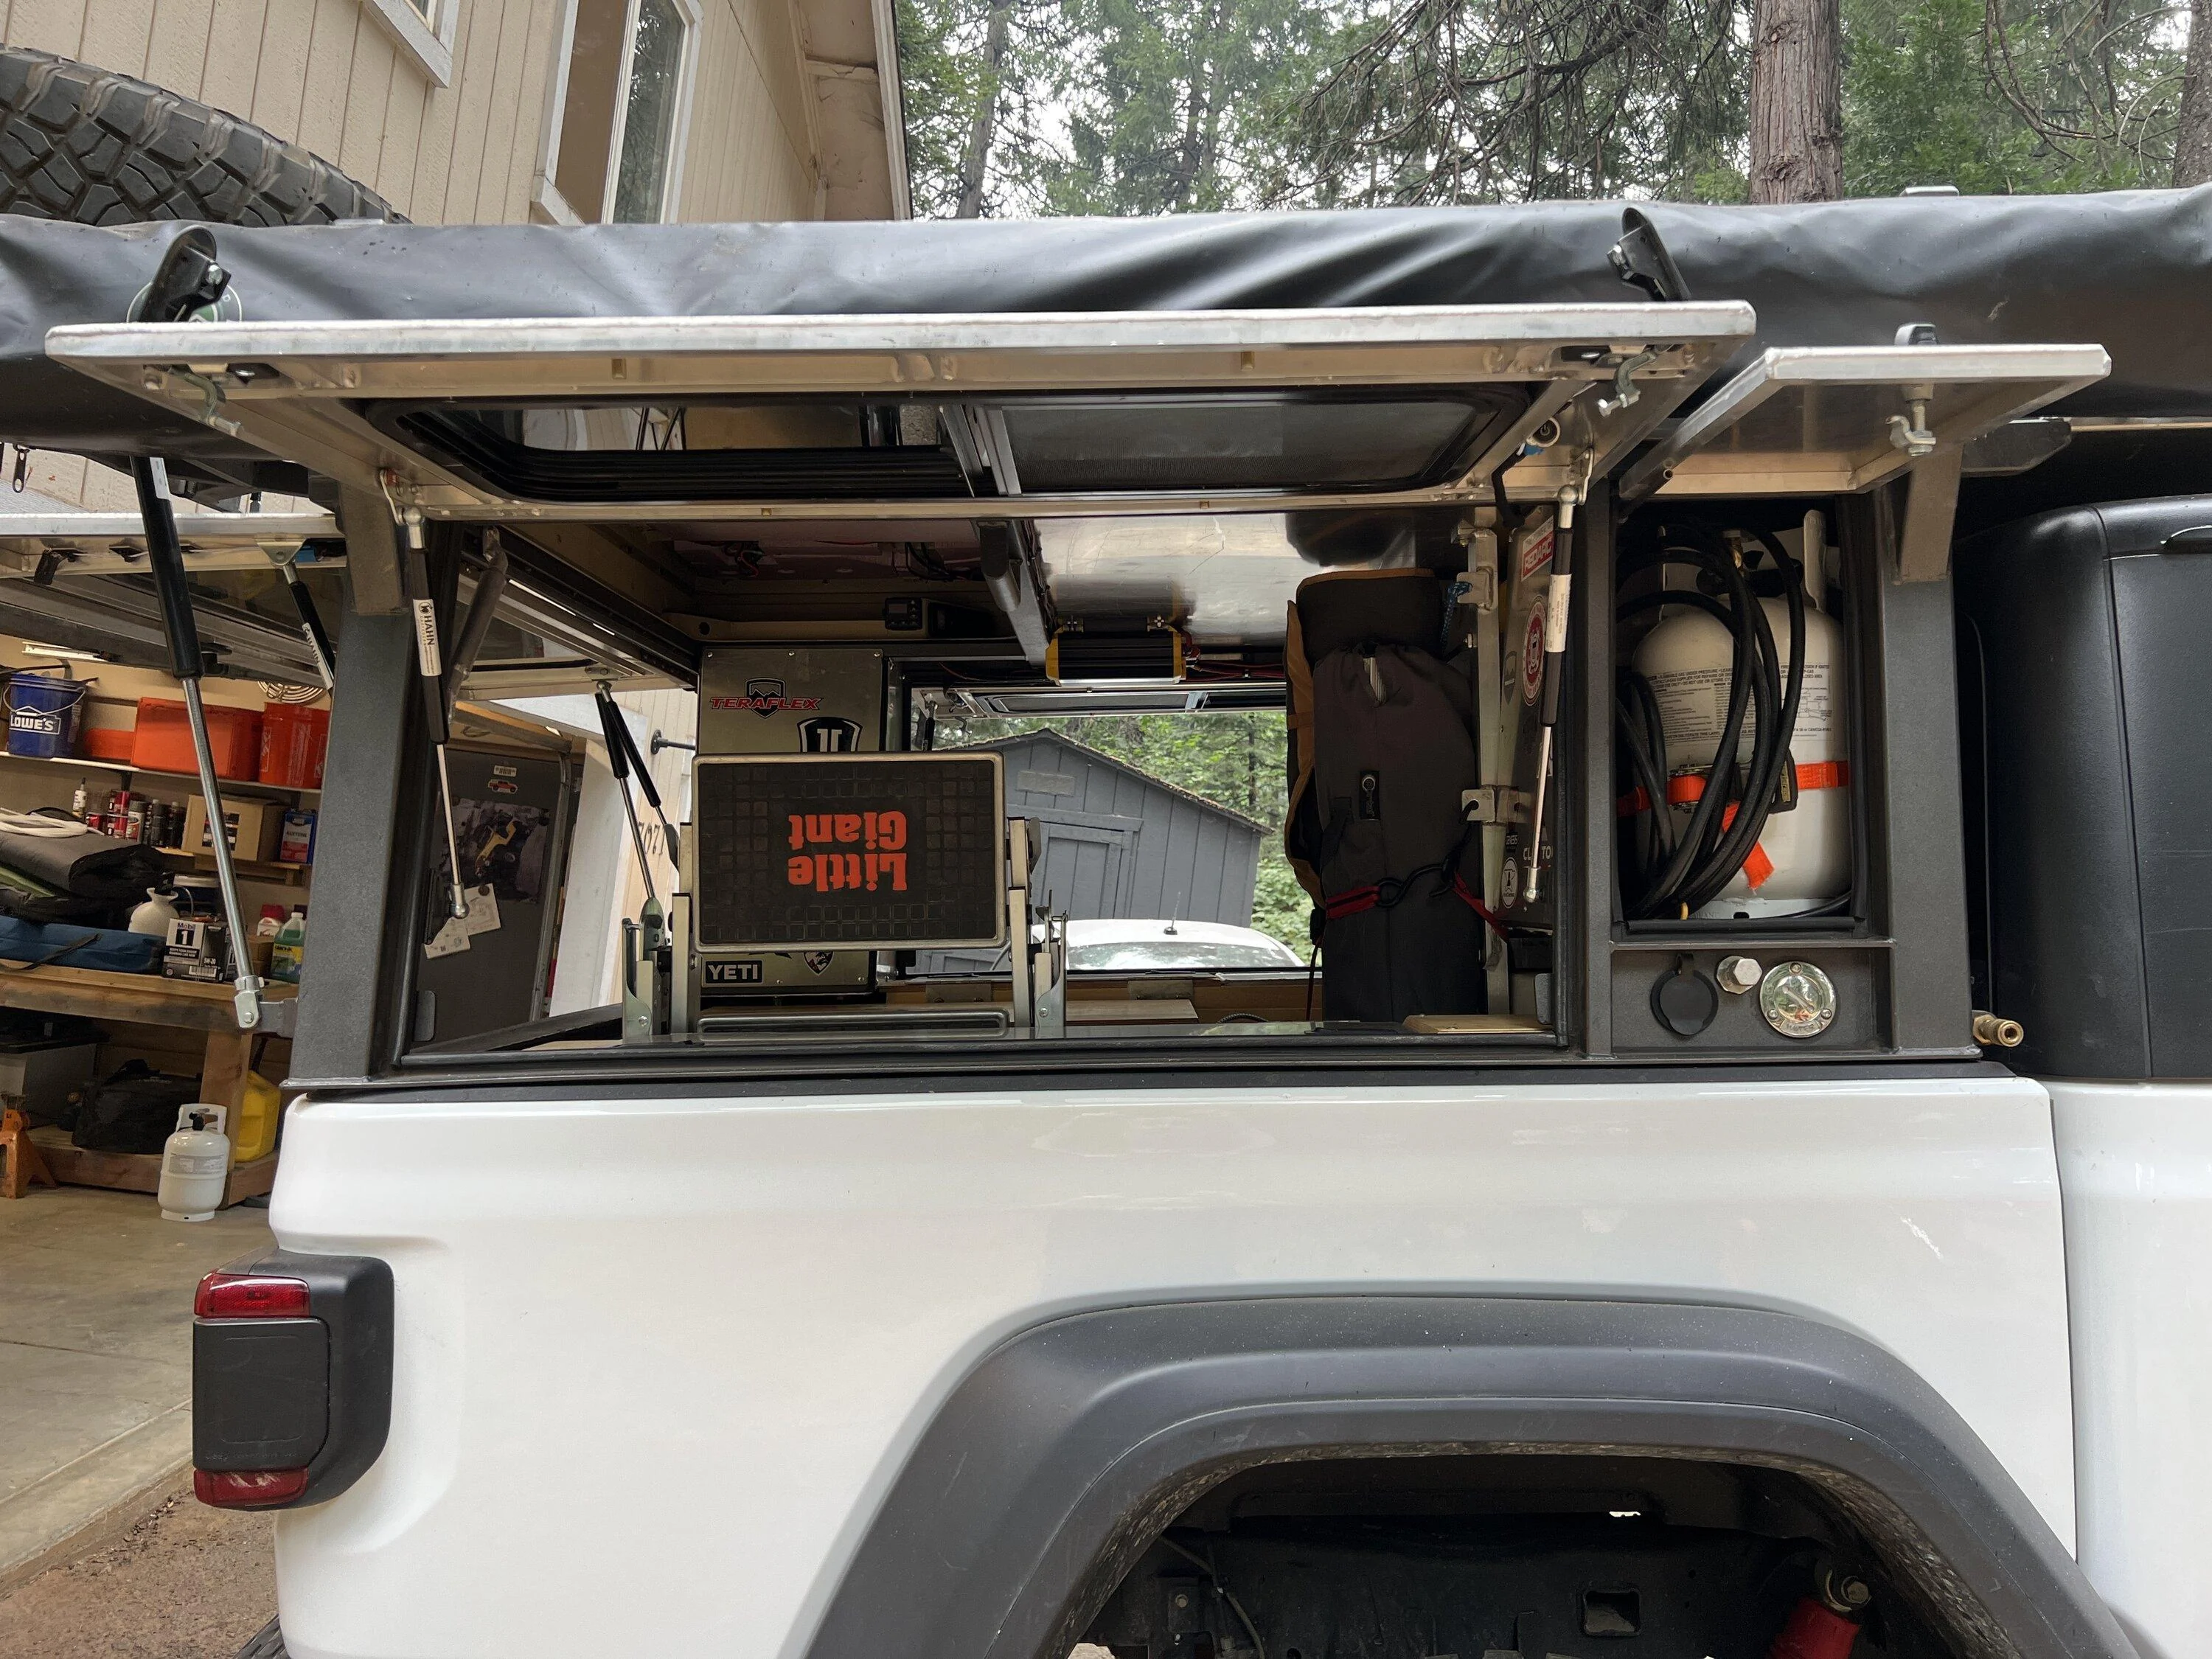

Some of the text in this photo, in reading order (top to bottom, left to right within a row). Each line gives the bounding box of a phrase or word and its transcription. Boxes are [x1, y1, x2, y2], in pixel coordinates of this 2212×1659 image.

[424, 615, 435, 645] HAHN
[710, 697, 824, 711] TERAFLEX
[10, 714, 54, 731] LOWE'S
[788, 811, 907, 850] Giant
[788, 853, 908, 891] Little
[181, 931, 188, 945] 1
[708, 964, 758, 980] YETI
